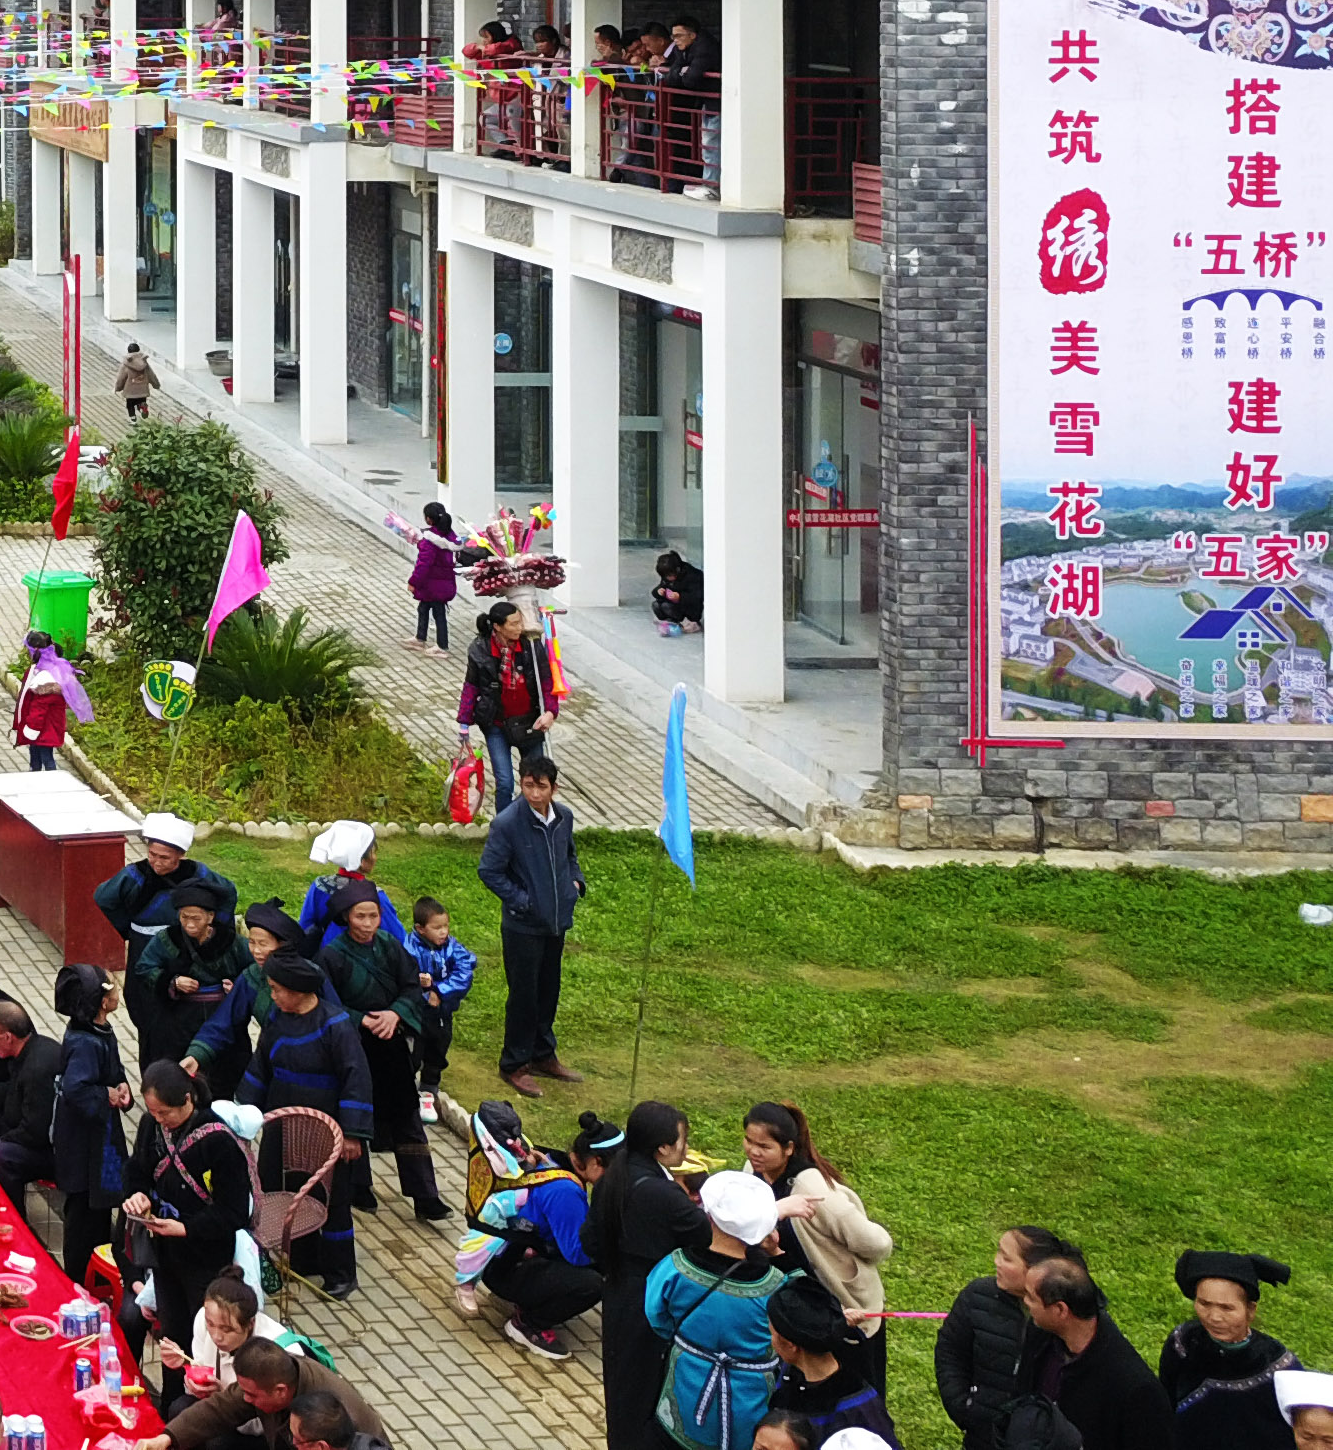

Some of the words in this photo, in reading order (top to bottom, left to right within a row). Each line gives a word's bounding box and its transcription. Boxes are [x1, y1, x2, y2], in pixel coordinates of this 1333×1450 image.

[1047, 30, 1106, 618] 共筑绣美雪花湖
